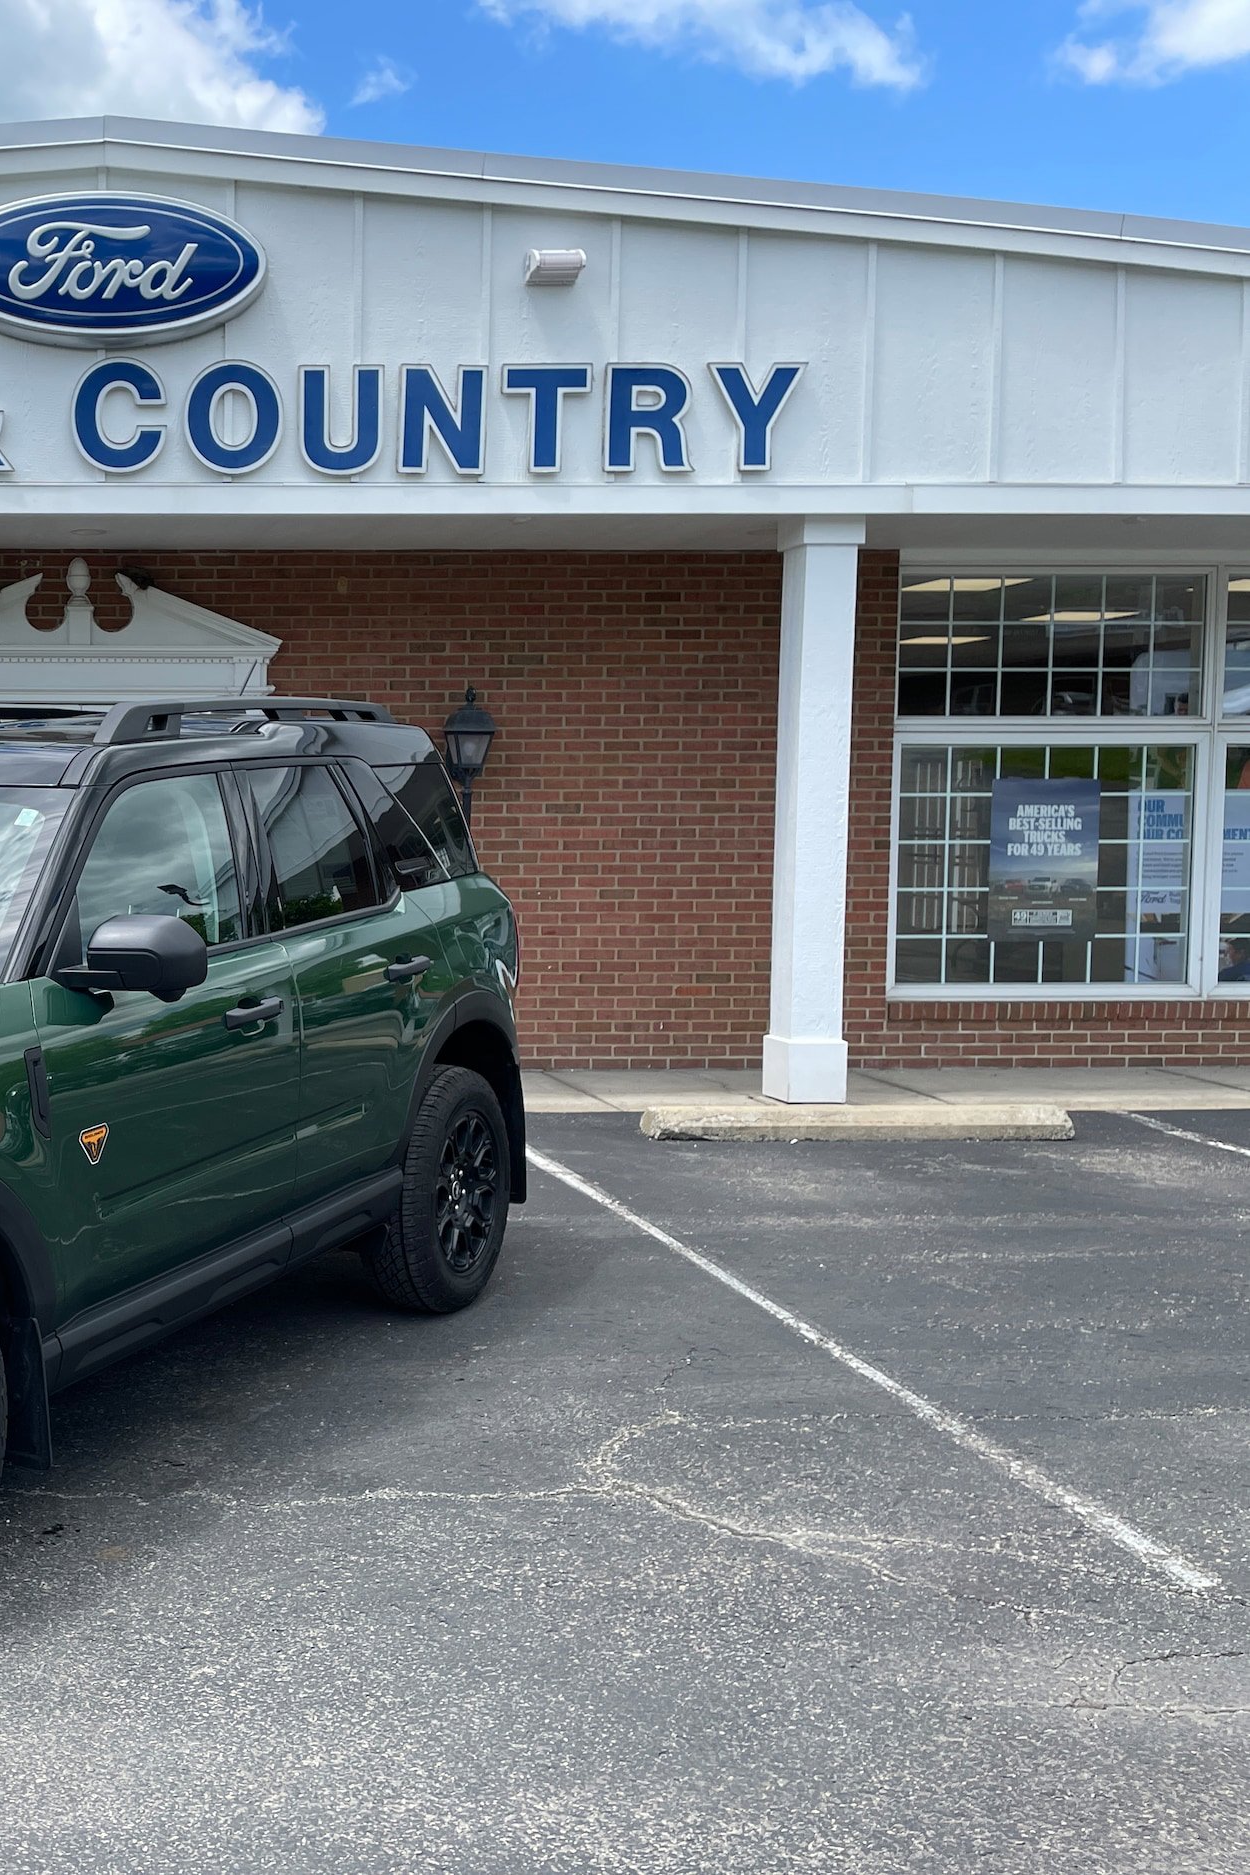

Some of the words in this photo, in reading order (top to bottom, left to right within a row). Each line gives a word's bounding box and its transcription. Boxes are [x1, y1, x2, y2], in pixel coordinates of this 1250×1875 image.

[7, 221, 199, 302] Ford
[72, 357, 810, 475] COUNTRY
[1017, 804, 1075, 817] AMERICA'S
[1008, 818, 1082, 830] BEST-SELLING
[1023, 831, 1065, 843] TRUCKS
[1007, 843, 1028, 856] FOR
[1030, 843, 1044, 856] 49
[1047, 843, 1081, 856] YEARS
